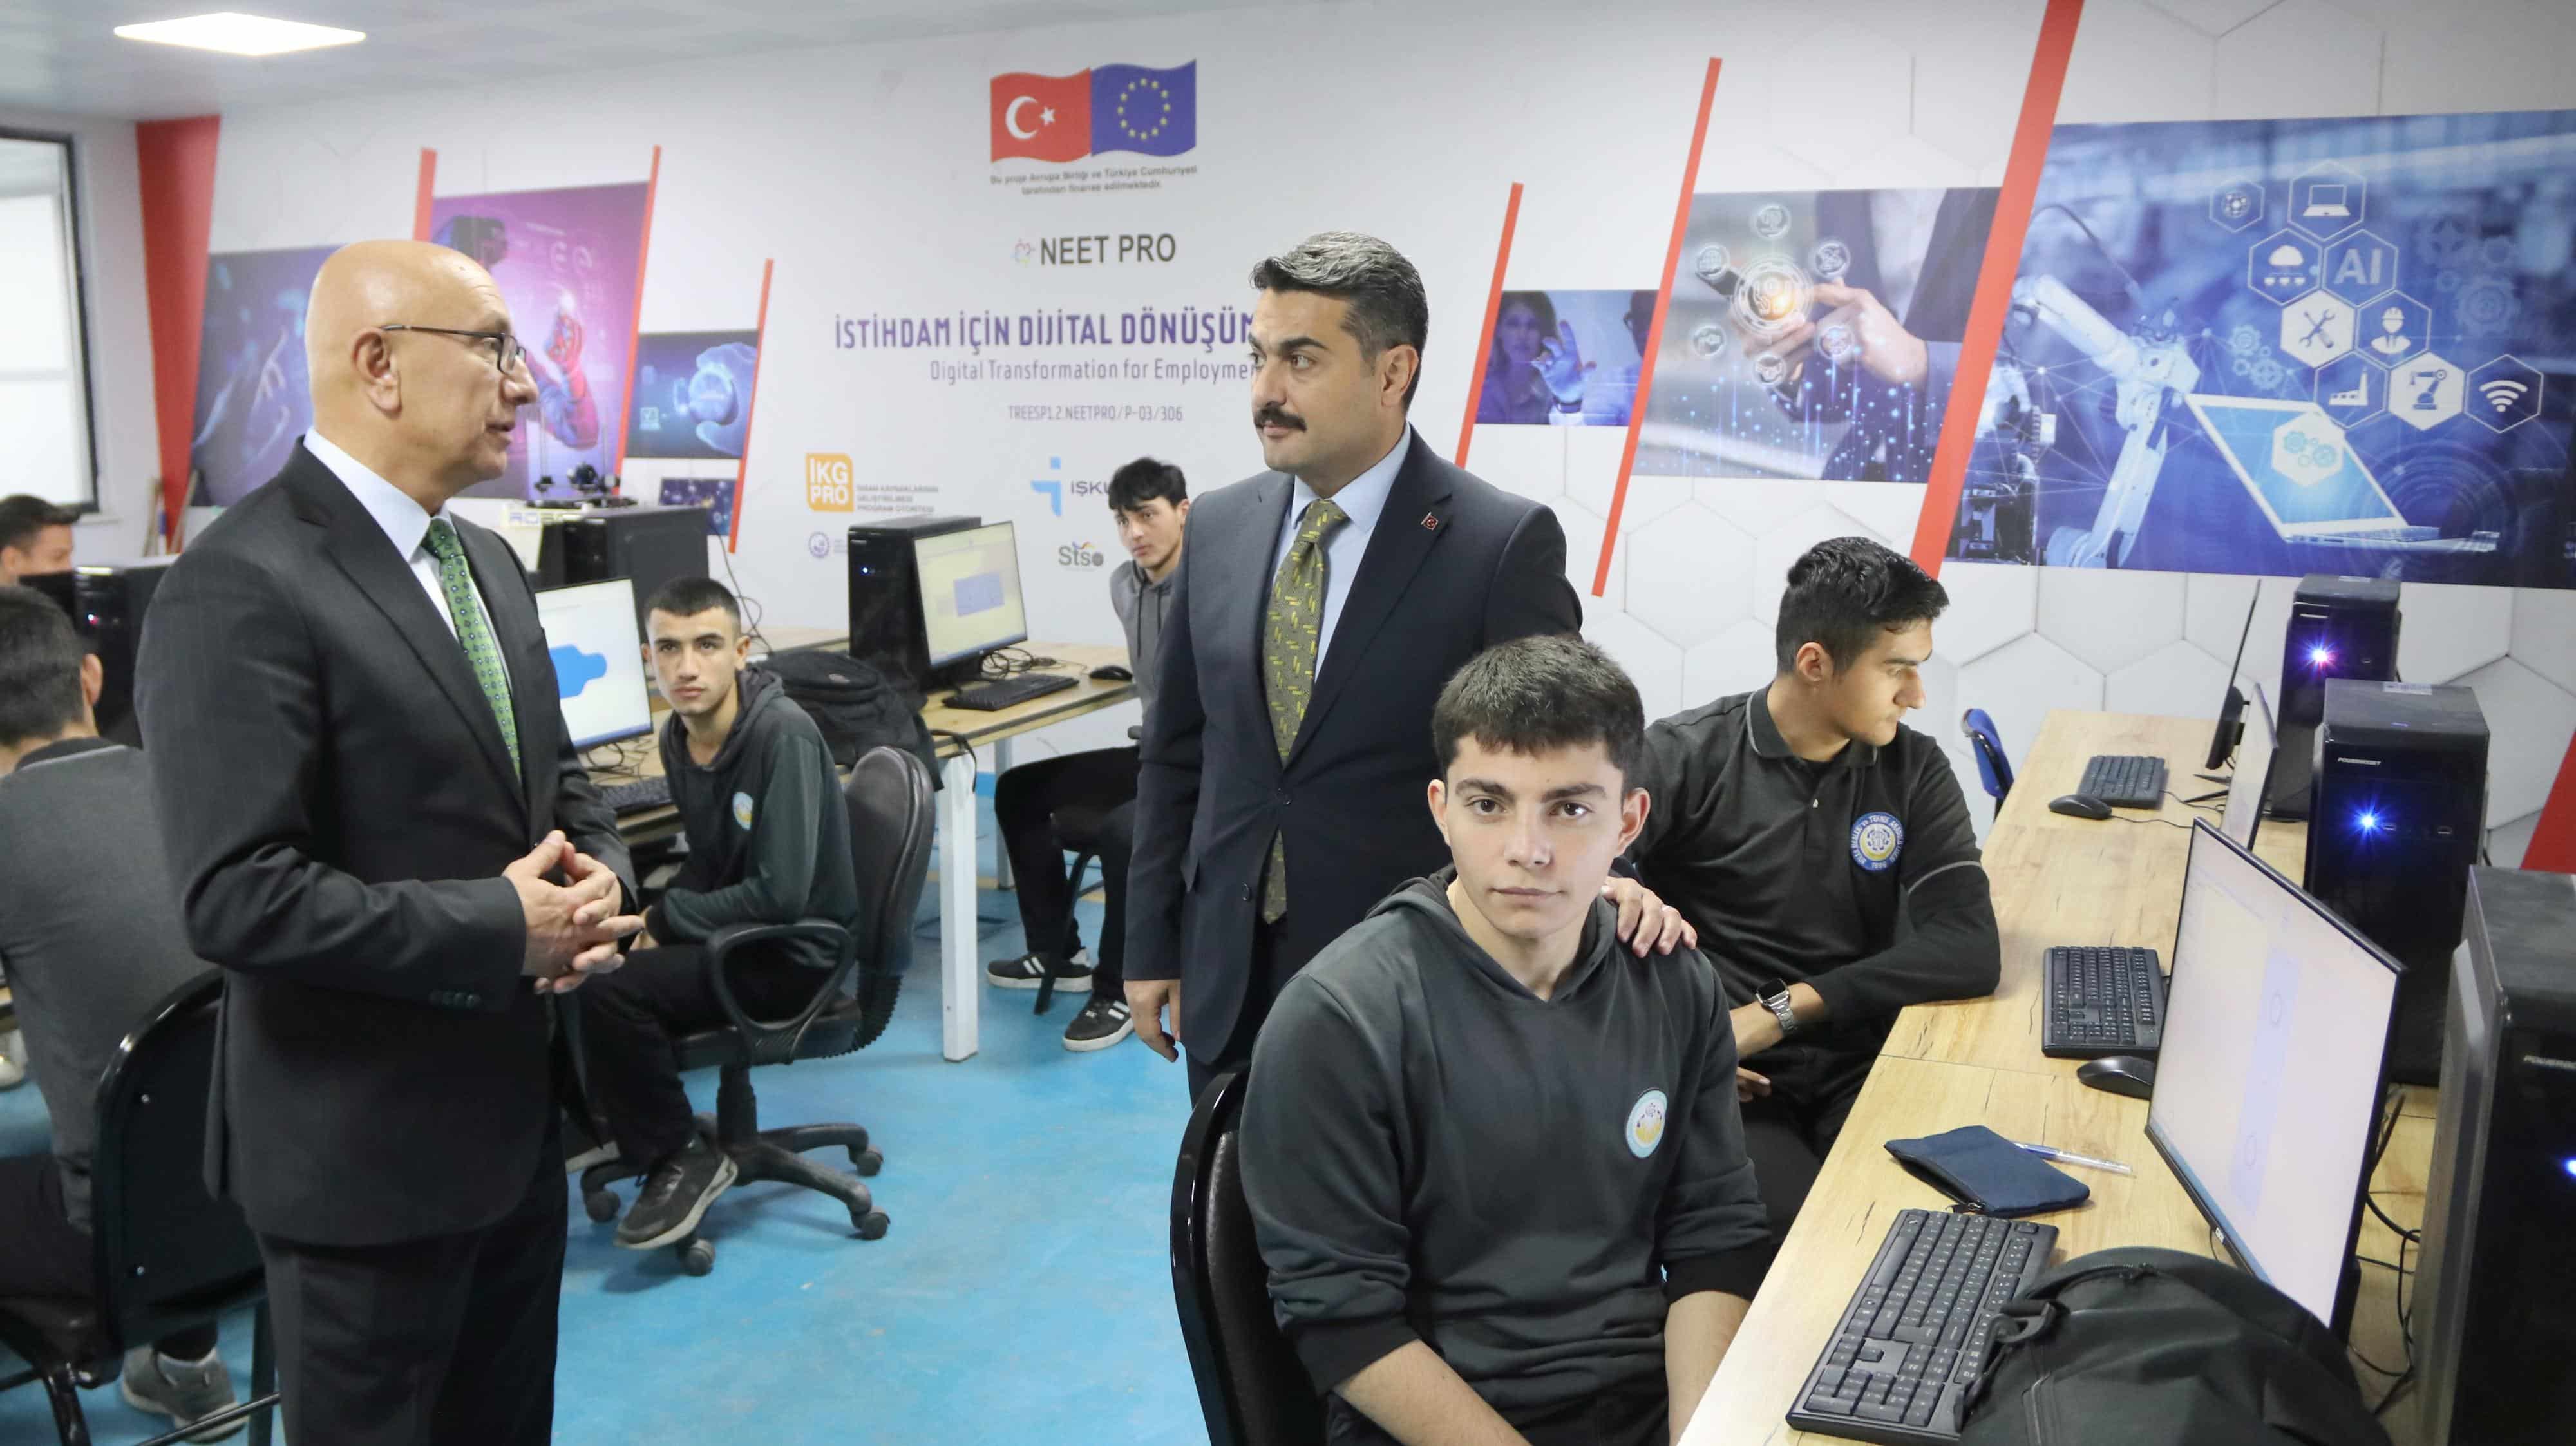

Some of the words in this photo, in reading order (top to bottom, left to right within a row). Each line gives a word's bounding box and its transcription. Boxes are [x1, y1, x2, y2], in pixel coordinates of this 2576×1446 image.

[1104, 167, 1138, 179] Türkiye
[1041, 236, 1110, 265] NEET
[1119, 233, 1176, 263] PRO
[2333, 247, 2382, 285] AI
[836, 314, 951, 349] İSTİHDAM
[960, 310, 1010, 356] İÇİN
[1019, 308, 1113, 346] DİJİTAL
[930, 359, 984, 386] Digital
[988, 358, 1119, 381] Transformation
[1122, 357, 1150, 379] for
[810, 485, 849, 505] PRO
